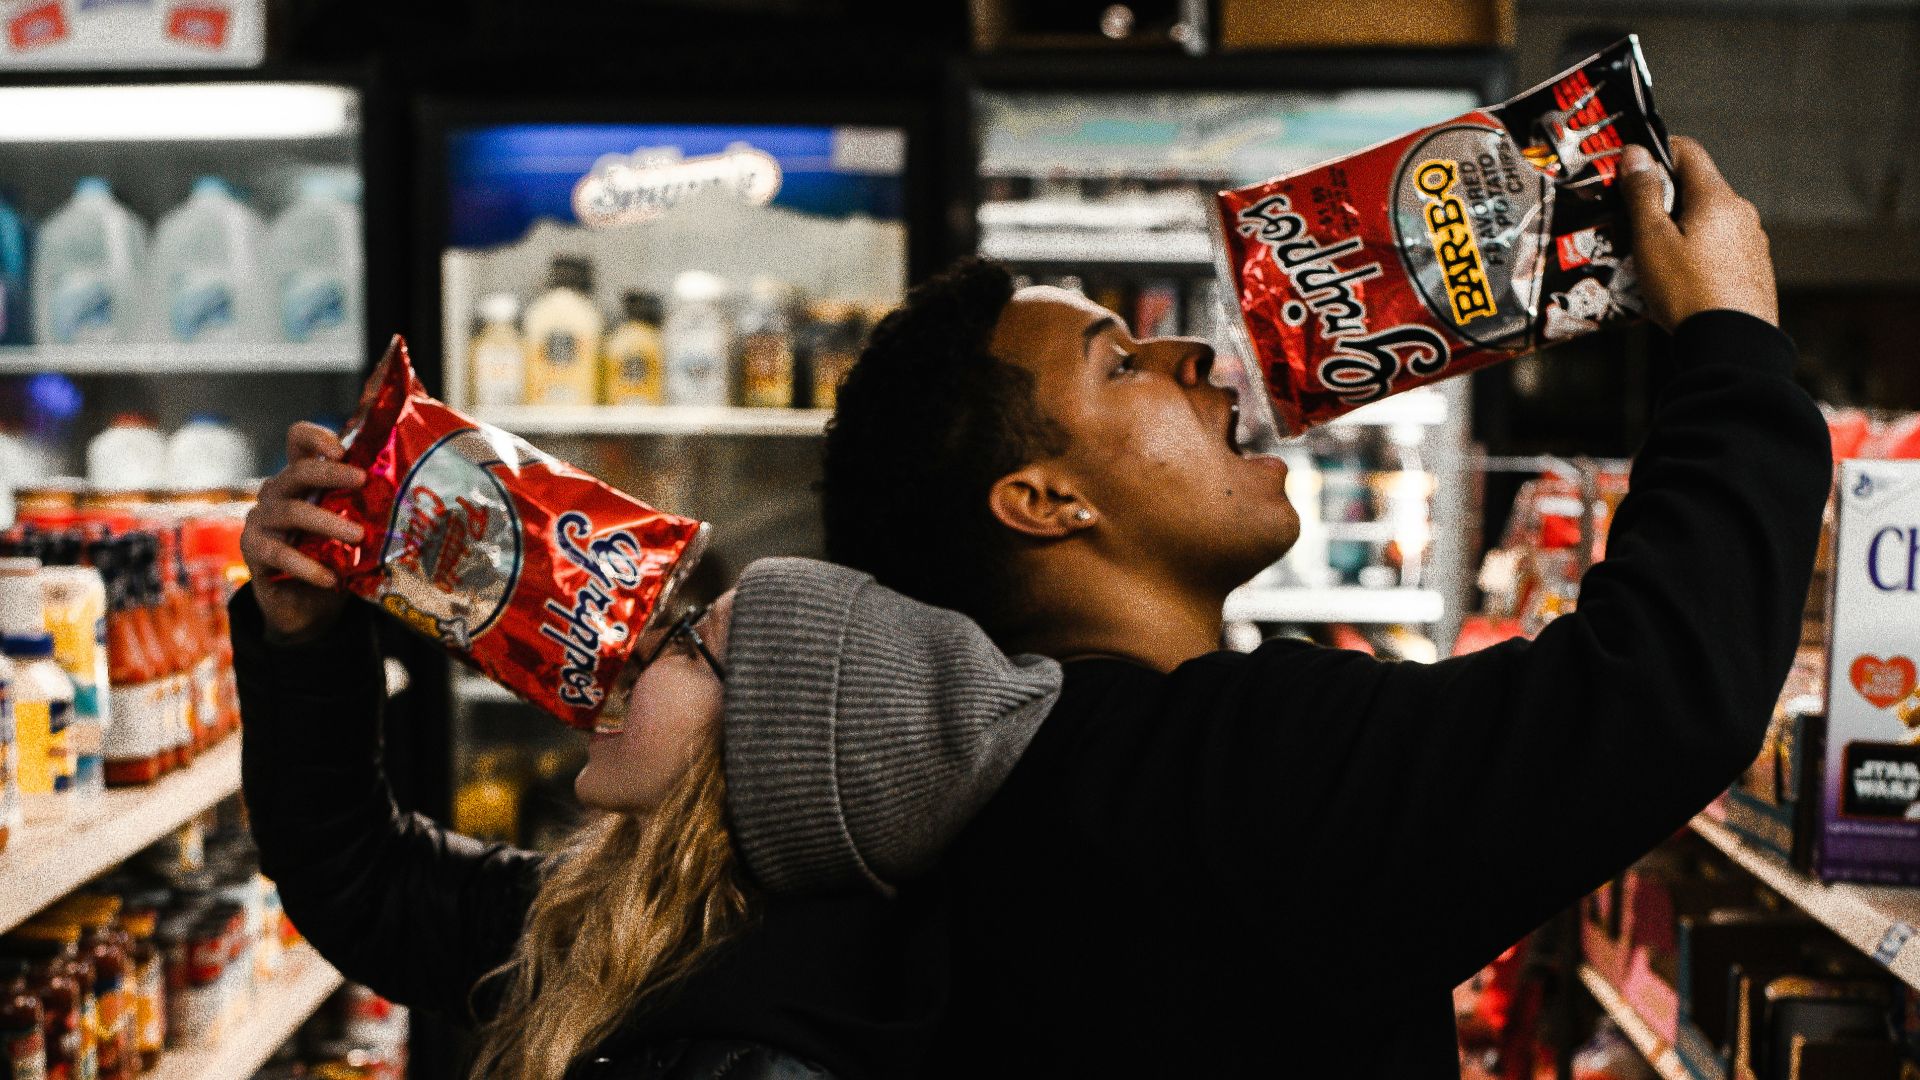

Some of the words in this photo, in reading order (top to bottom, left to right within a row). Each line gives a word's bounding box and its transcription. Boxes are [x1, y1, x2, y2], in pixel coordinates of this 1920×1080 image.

[1459, 160, 1504, 265] FLAVORED
[1478, 153, 1512, 227] POTATO
[1240, 195, 1448, 403] Grippo's
[541, 512, 641, 707] Grippo's
